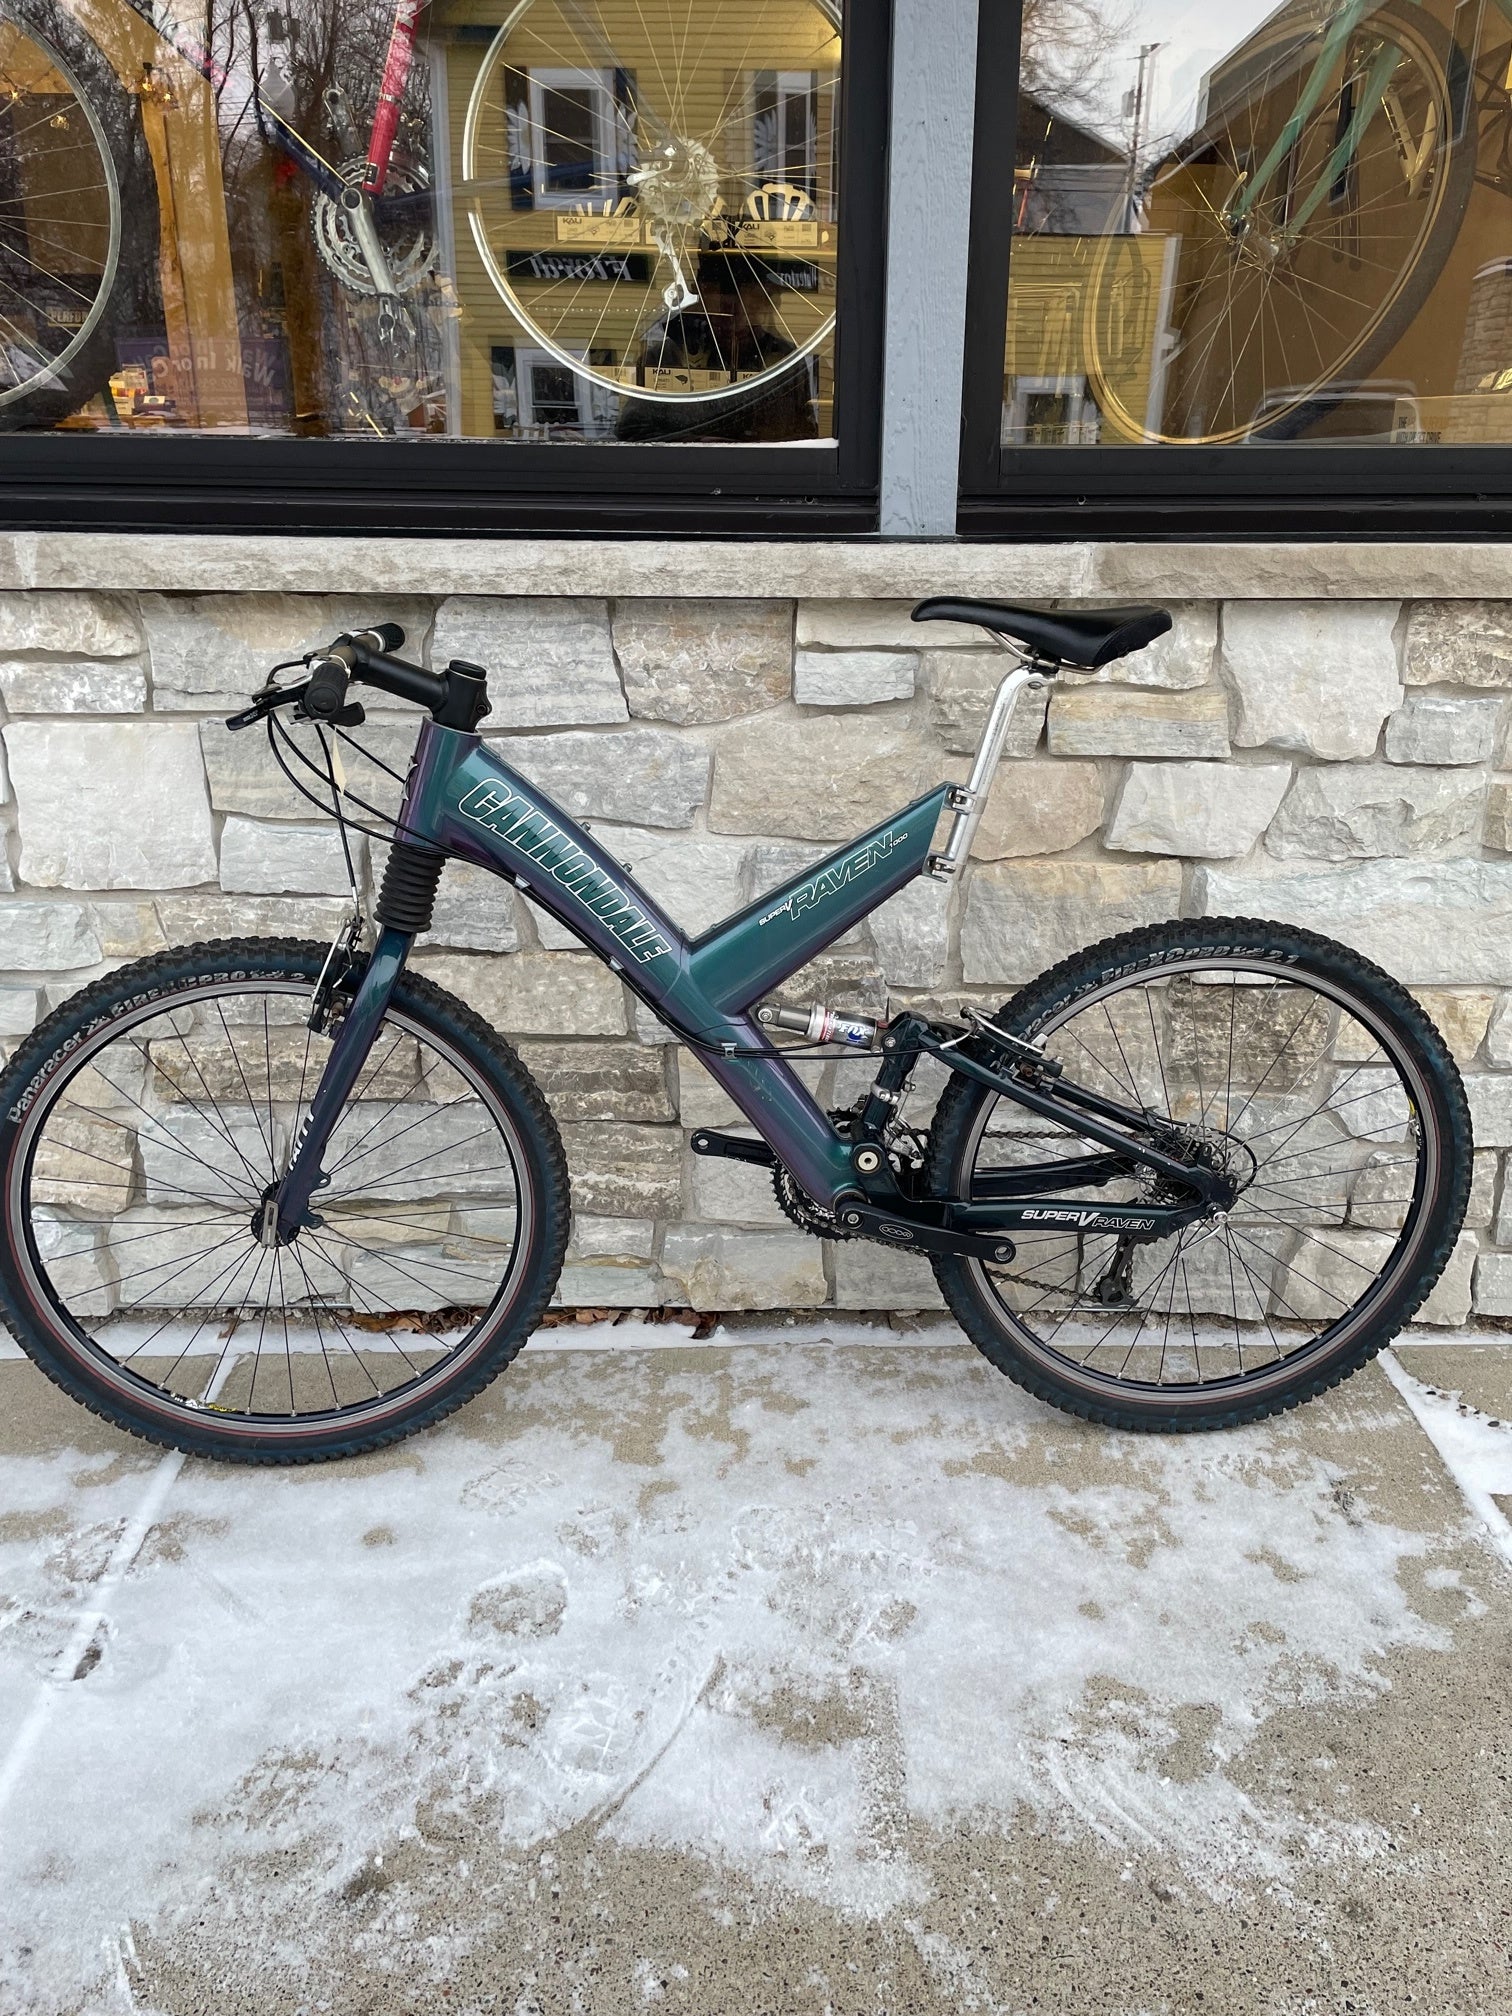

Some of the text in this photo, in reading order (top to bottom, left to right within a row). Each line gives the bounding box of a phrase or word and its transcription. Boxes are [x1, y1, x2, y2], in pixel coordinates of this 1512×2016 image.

[562, 217, 582, 225] KALI
[458, 777, 673, 964] CANNONDALE
[789, 831, 893, 921] RAVEN
[888, 832, 909, 849] 1000
[6, 1030, 83, 1124] Panaracer
[1092, 1216, 1156, 1231] RAVEN
